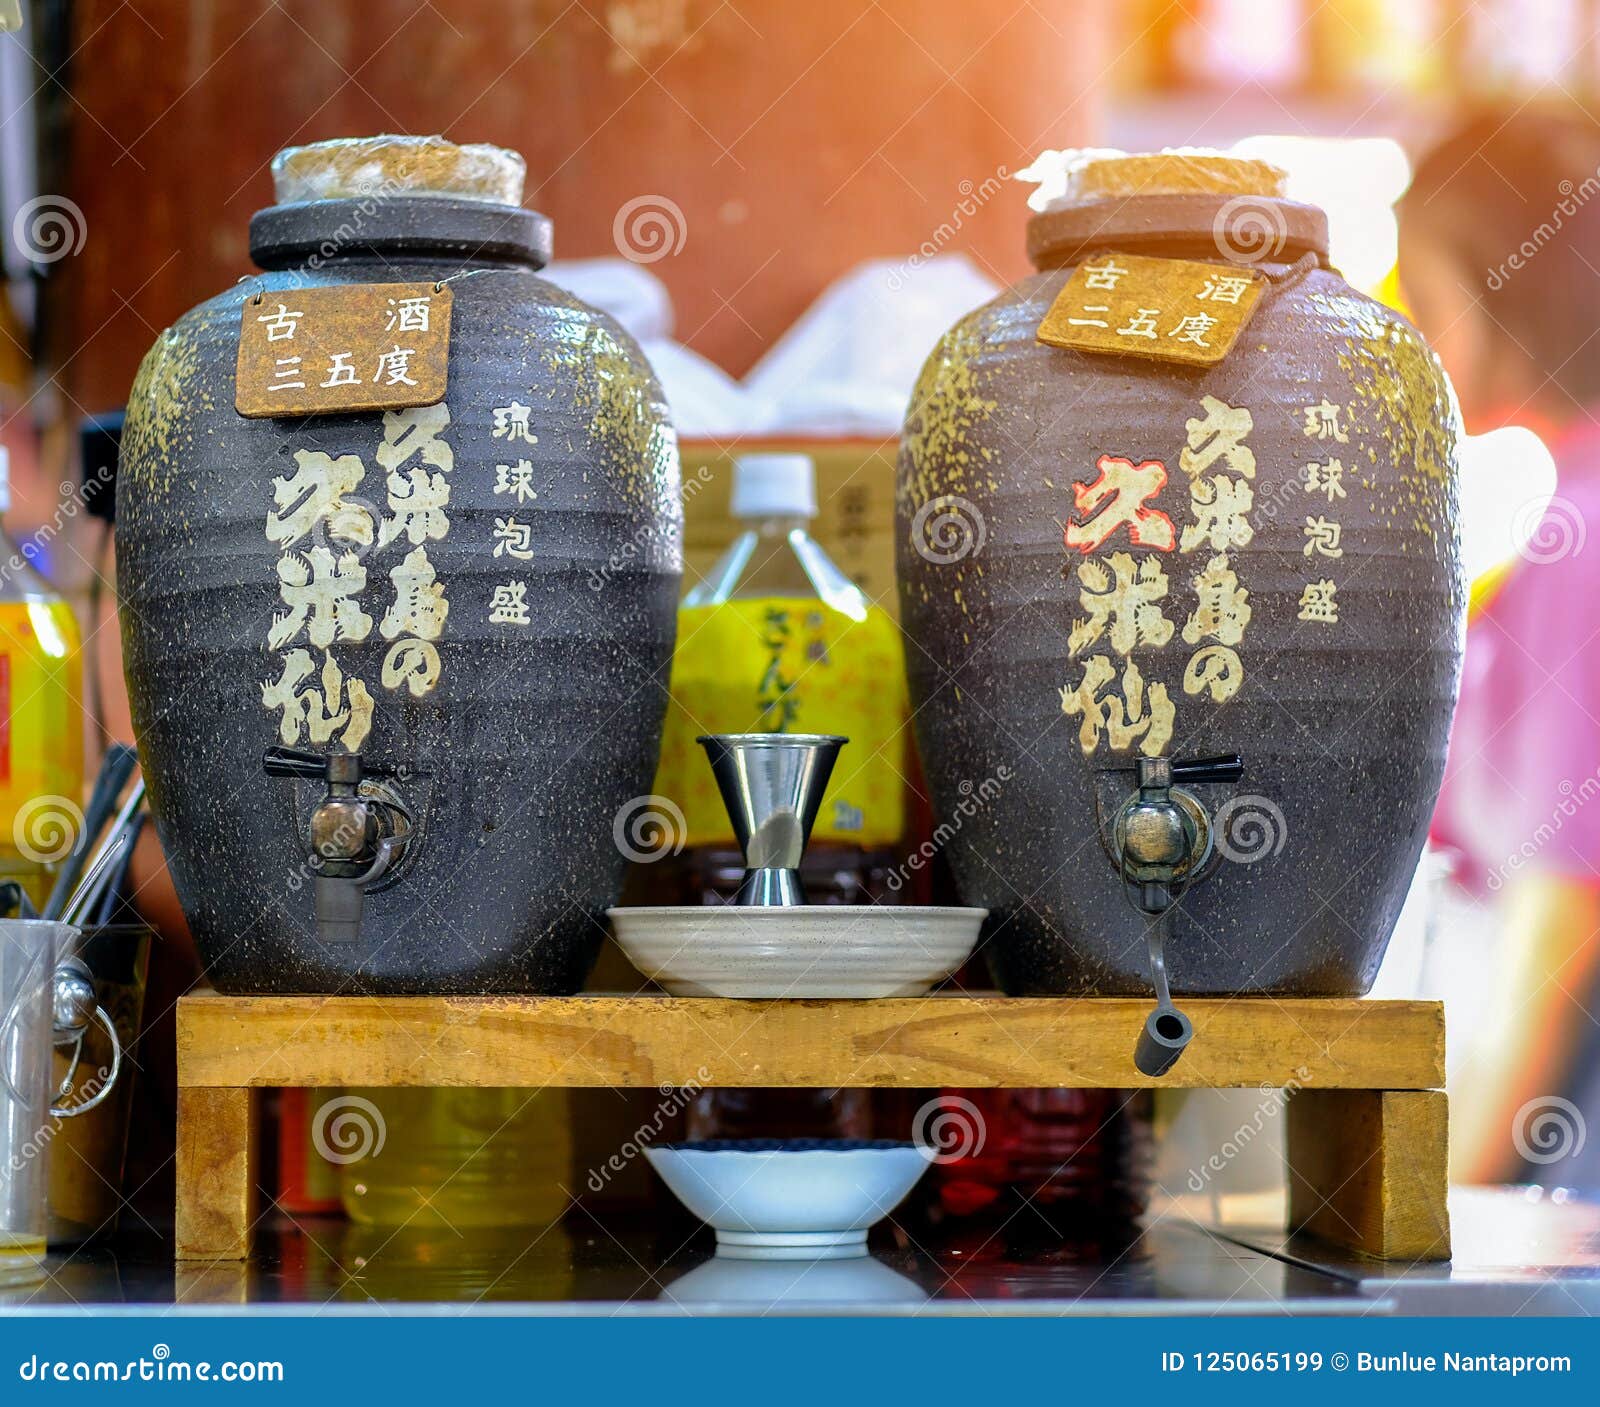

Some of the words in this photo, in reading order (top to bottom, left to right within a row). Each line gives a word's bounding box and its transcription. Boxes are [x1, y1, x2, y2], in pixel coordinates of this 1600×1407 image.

[267, 344, 418, 391] 三五度
[1068, 305, 1218, 347] 二五度
[260, 448, 374, 753] 久米仙
[377, 402, 454, 697] 久米島の
[489, 401, 538, 625] 琉球泡盛
[1058, 454, 1176, 757] 久米仙
[1179, 395, 1256, 703] 久米島の
[1298, 400, 1348, 623] 琉球泡盛
